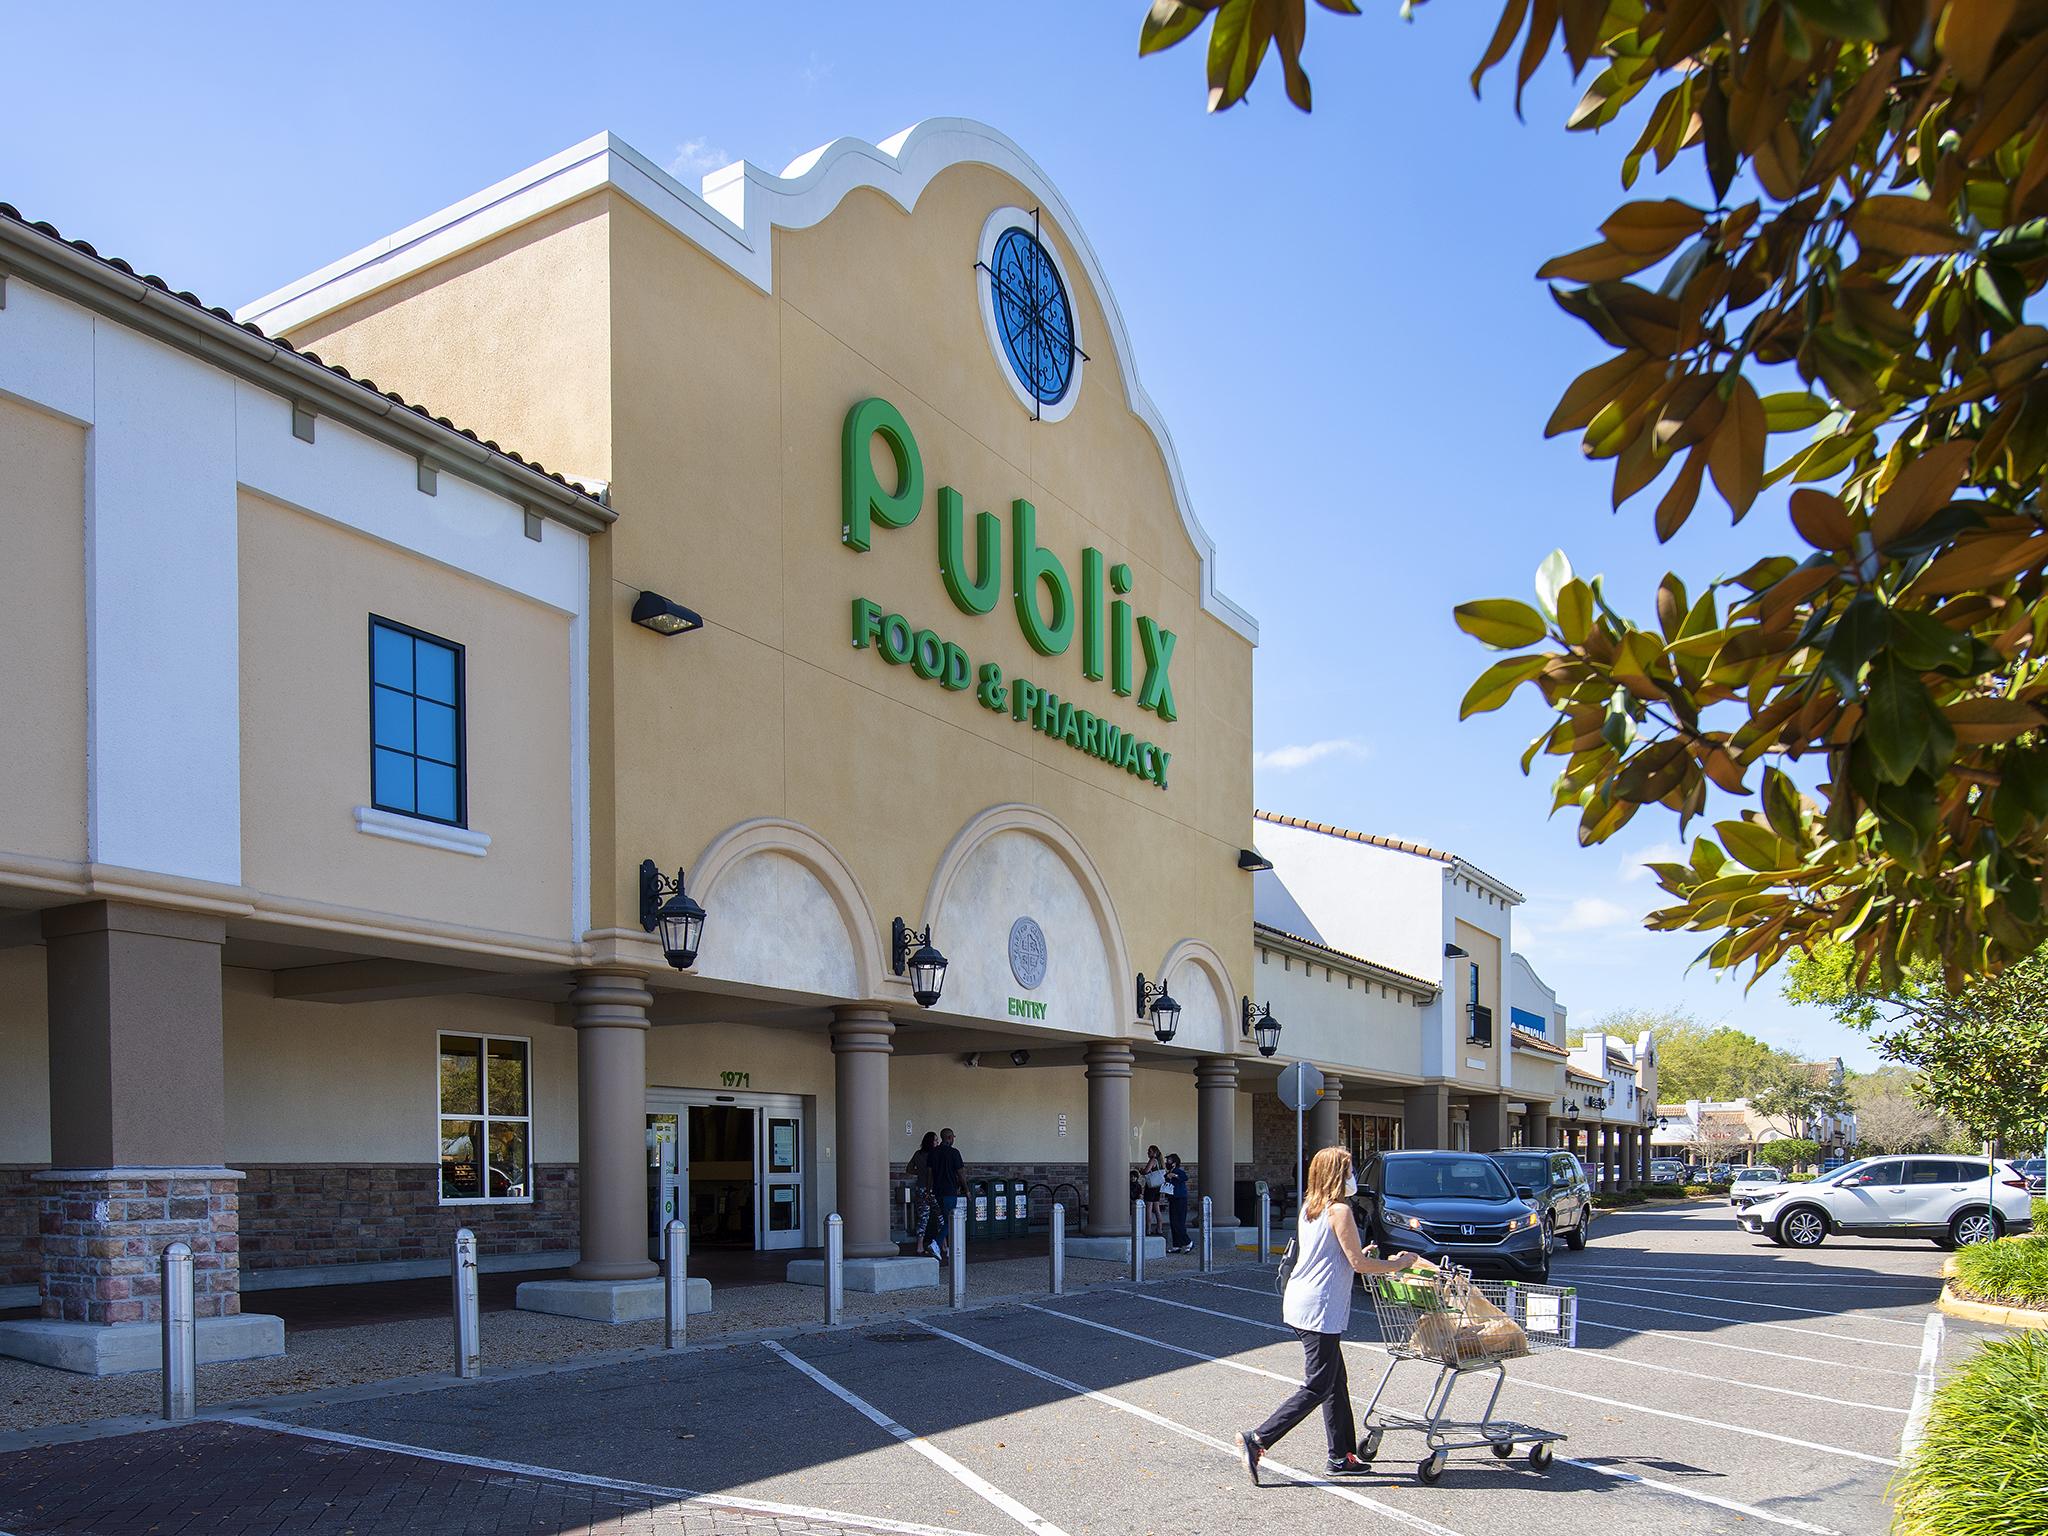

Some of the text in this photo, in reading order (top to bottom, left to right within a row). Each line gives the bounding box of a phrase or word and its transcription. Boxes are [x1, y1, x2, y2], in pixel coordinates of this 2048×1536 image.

[842, 397, 1177, 722] Publix
[852, 597, 1172, 789] FOOD & PHARMACY
[1008, 997, 1048, 1020] ENTRY
[720, 1071, 750, 1088] 1971
